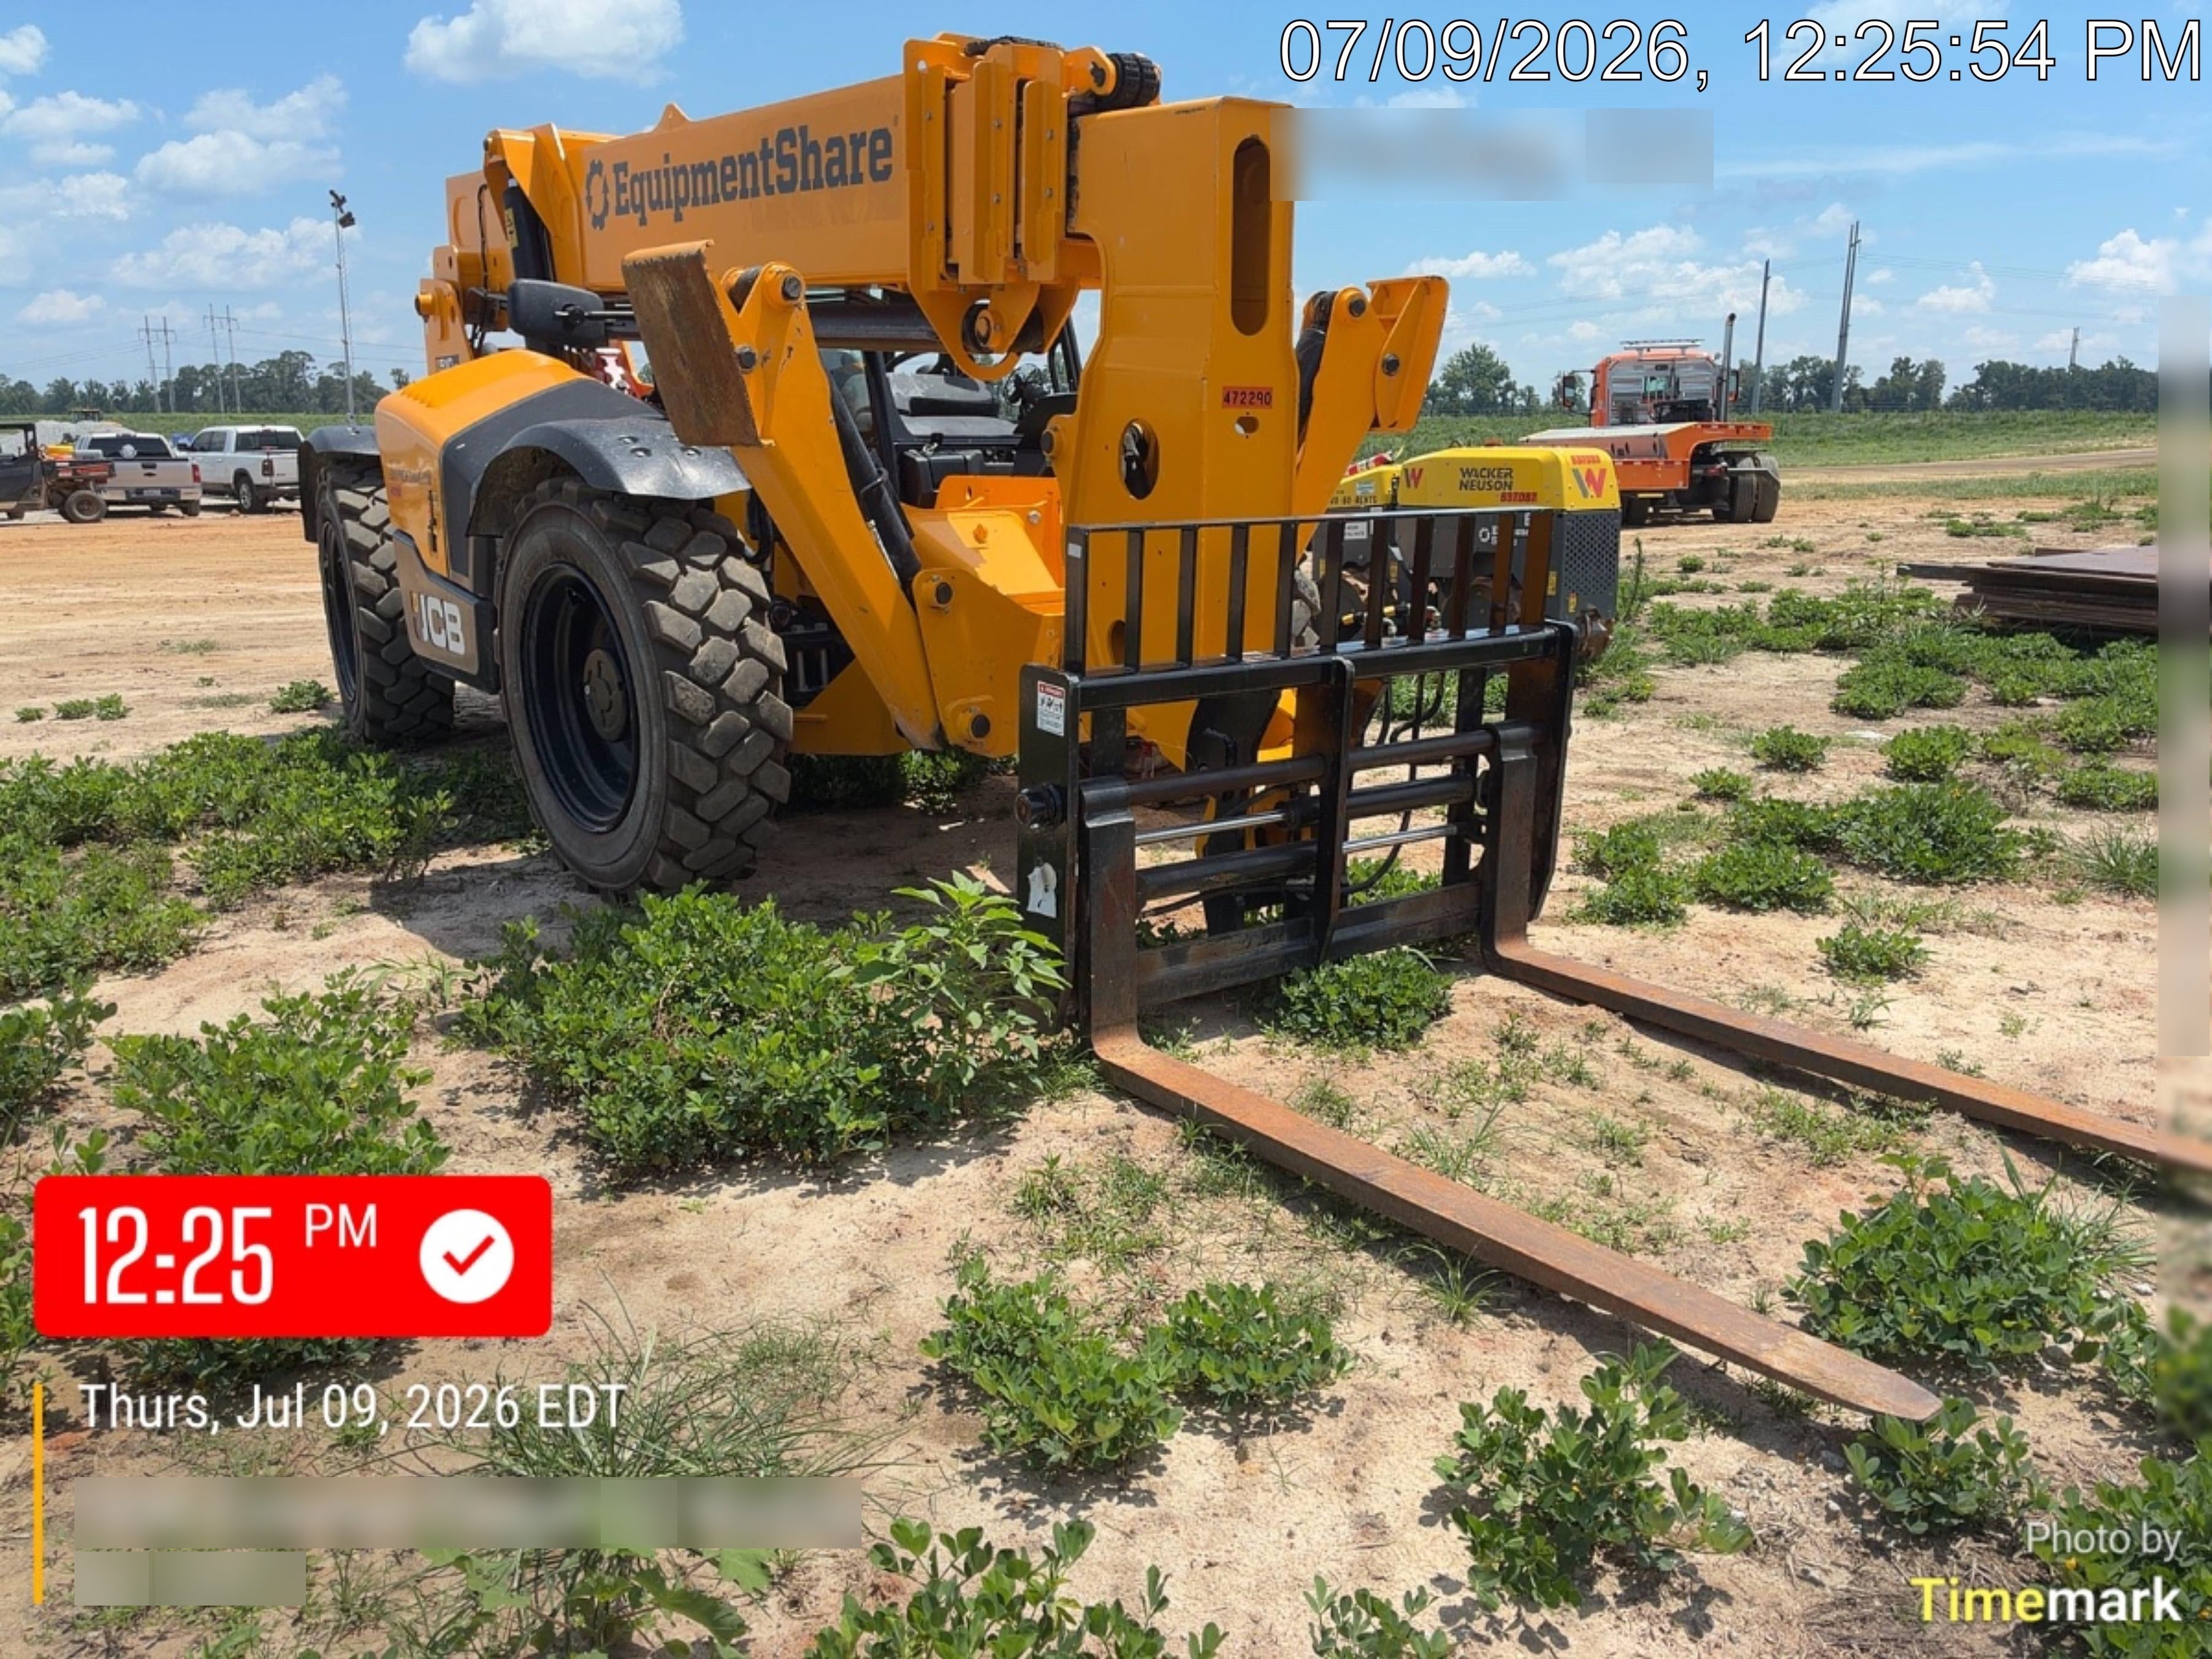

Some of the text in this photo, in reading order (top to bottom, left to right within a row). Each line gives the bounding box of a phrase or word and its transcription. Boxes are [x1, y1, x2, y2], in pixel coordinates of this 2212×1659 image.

[614, 124, 893, 227] EquipmentShare
[1223, 390, 1273, 406] 472290
[1459, 467, 1513, 479] WACKER
[1459, 479, 1513, 491] NEUSON
[415, 593, 465, 656] JCB
